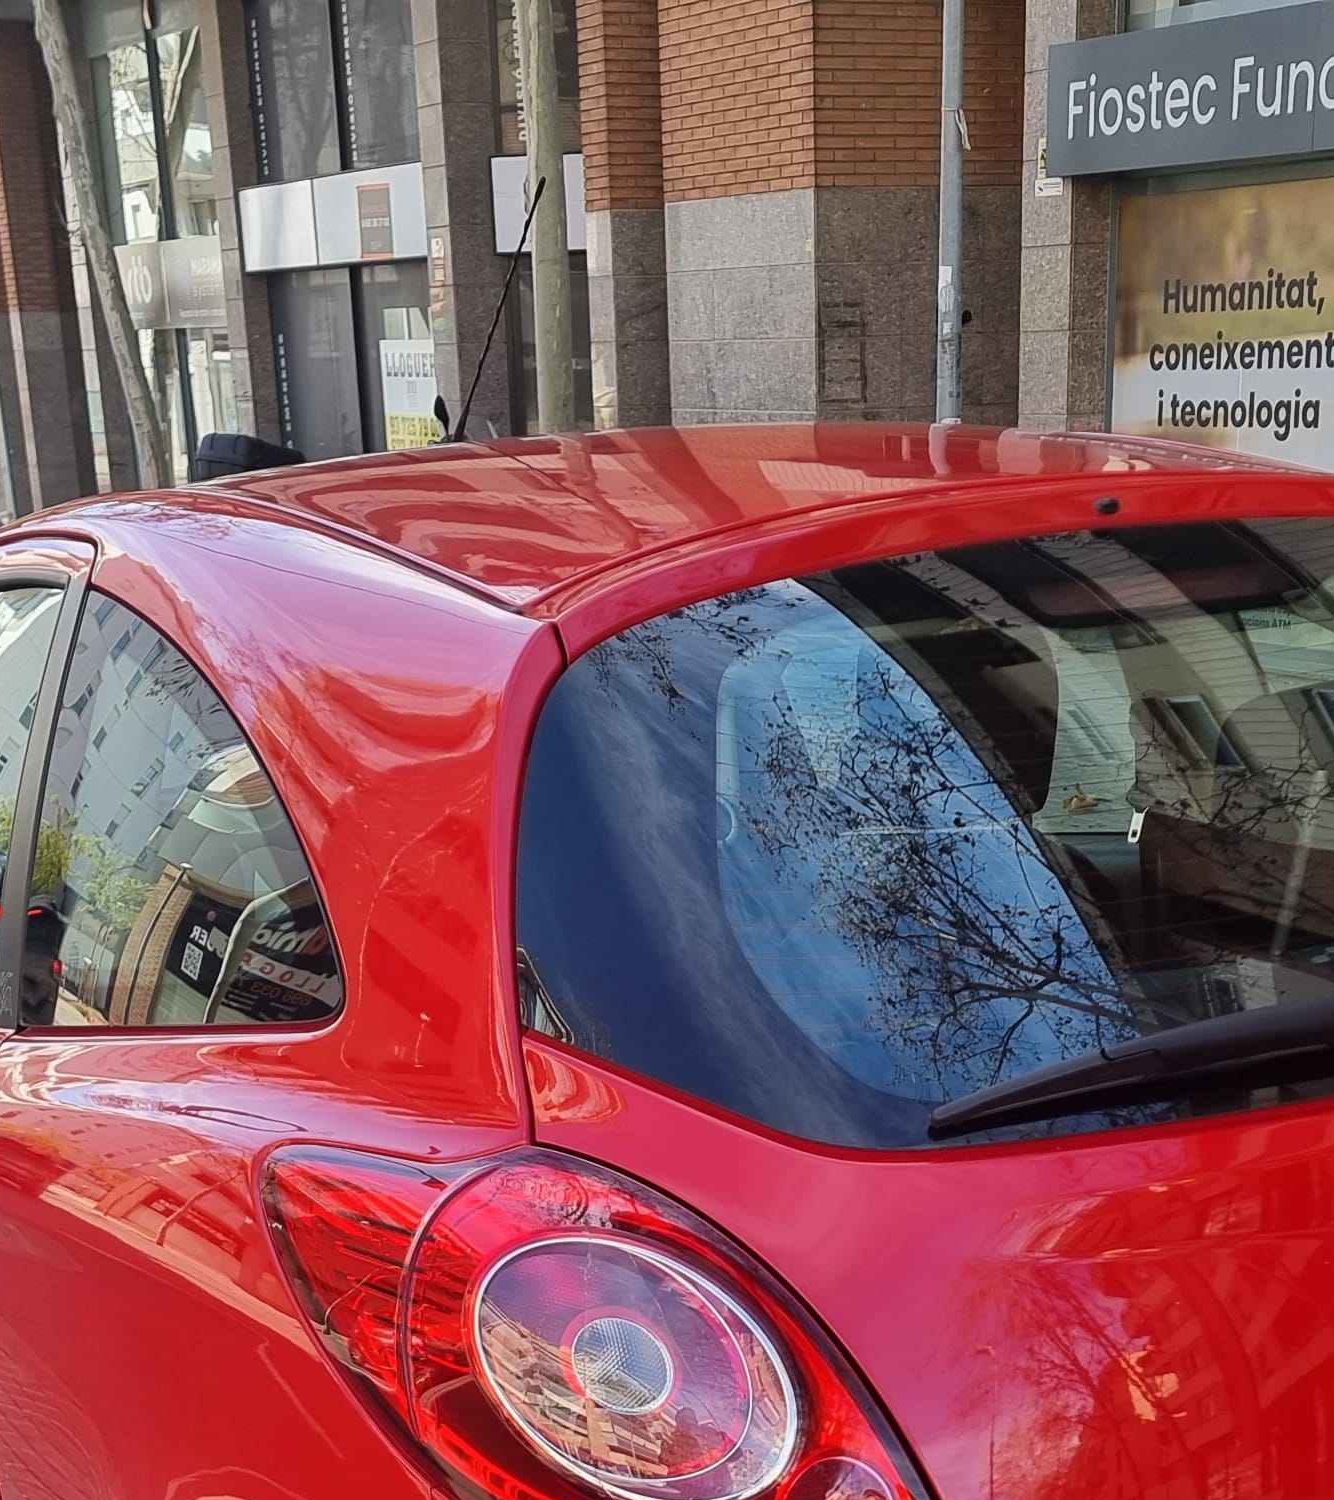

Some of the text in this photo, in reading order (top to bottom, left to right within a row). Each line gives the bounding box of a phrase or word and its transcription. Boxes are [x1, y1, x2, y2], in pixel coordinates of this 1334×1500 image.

[1067, 73, 1216, 140] Fiostec
[1163, 268, 1326, 315] Humanitat,
[1157, 387, 1321, 441] i tecnologia
